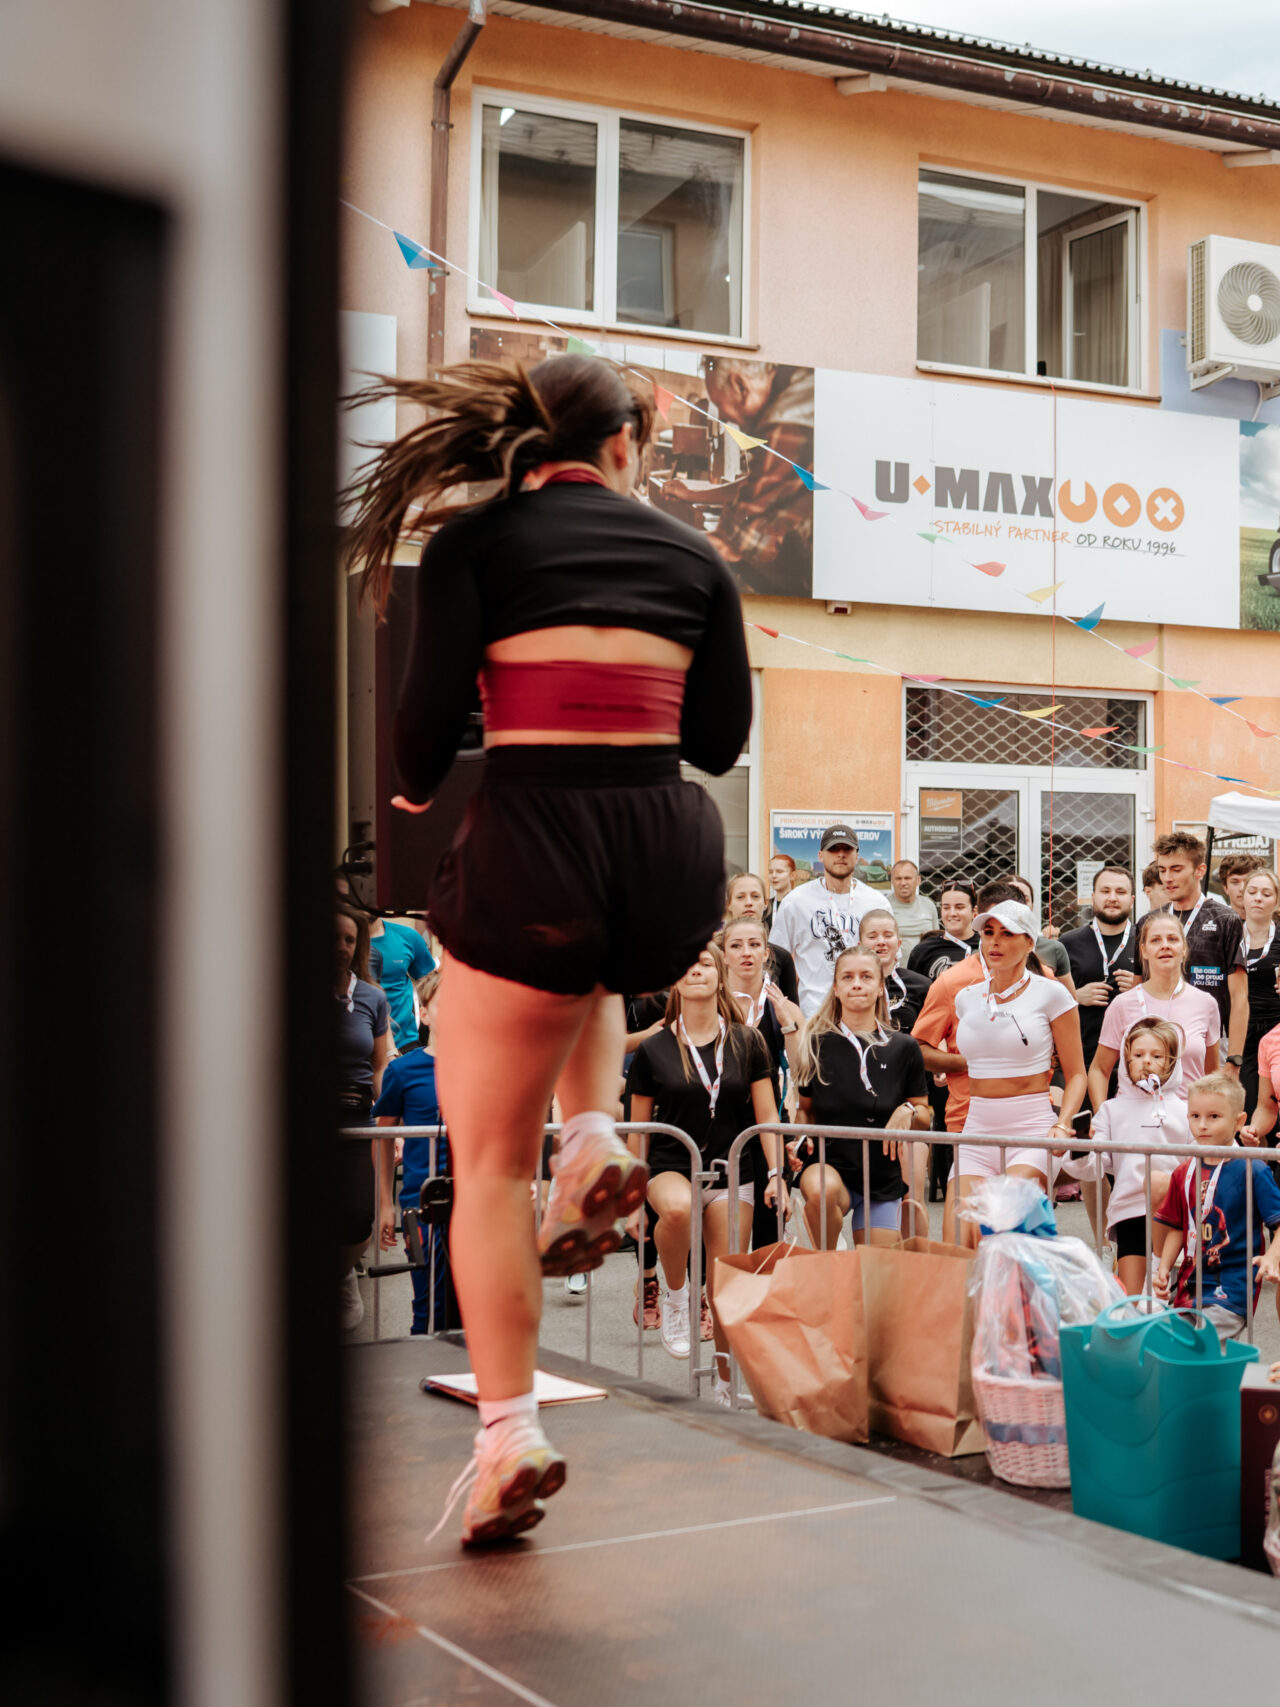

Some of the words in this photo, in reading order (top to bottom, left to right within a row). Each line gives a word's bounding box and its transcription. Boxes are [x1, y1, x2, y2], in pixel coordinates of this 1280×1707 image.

[933, 520, 1002, 538] STABILNÝ
[1008, 526, 1072, 544] PARTNER
[1076, 533, 1097, 548] OD
[1103, 535, 1142, 551] ROKU
[1146, 540, 1177, 556] 1996
[779, 827, 809, 840] ŠIROKÝ
